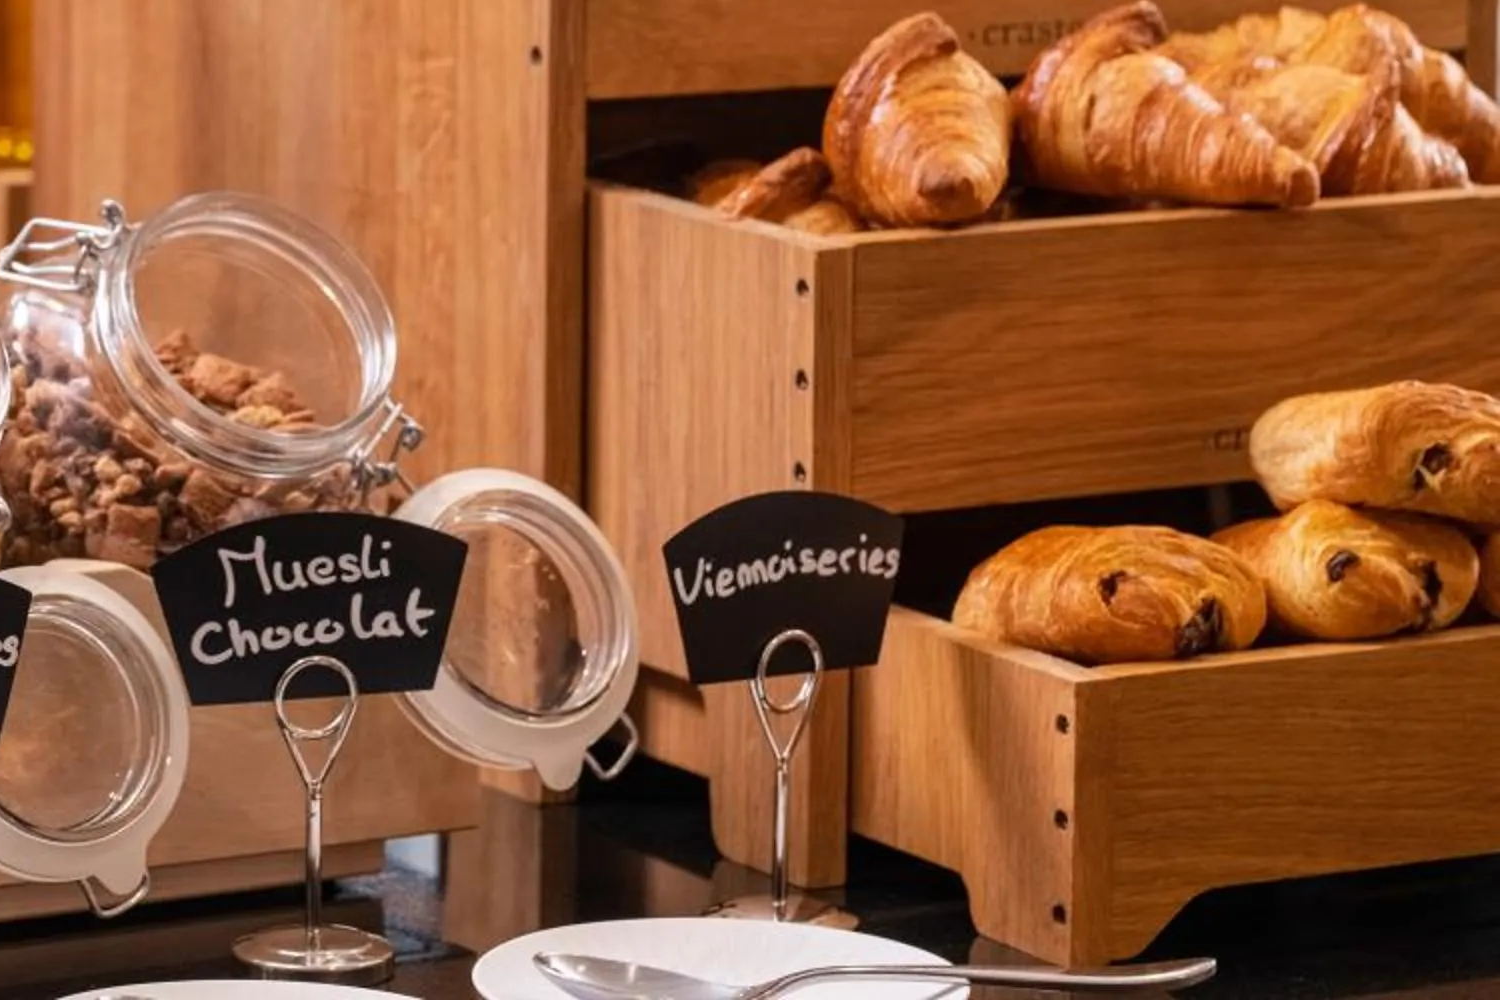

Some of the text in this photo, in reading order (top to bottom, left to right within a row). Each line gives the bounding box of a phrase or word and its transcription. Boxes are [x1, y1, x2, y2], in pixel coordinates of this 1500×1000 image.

[216, 532, 393, 609] Muesli
[672, 532, 901, 606] Viennoiseries
[190, 585, 436, 666] Chocolat
